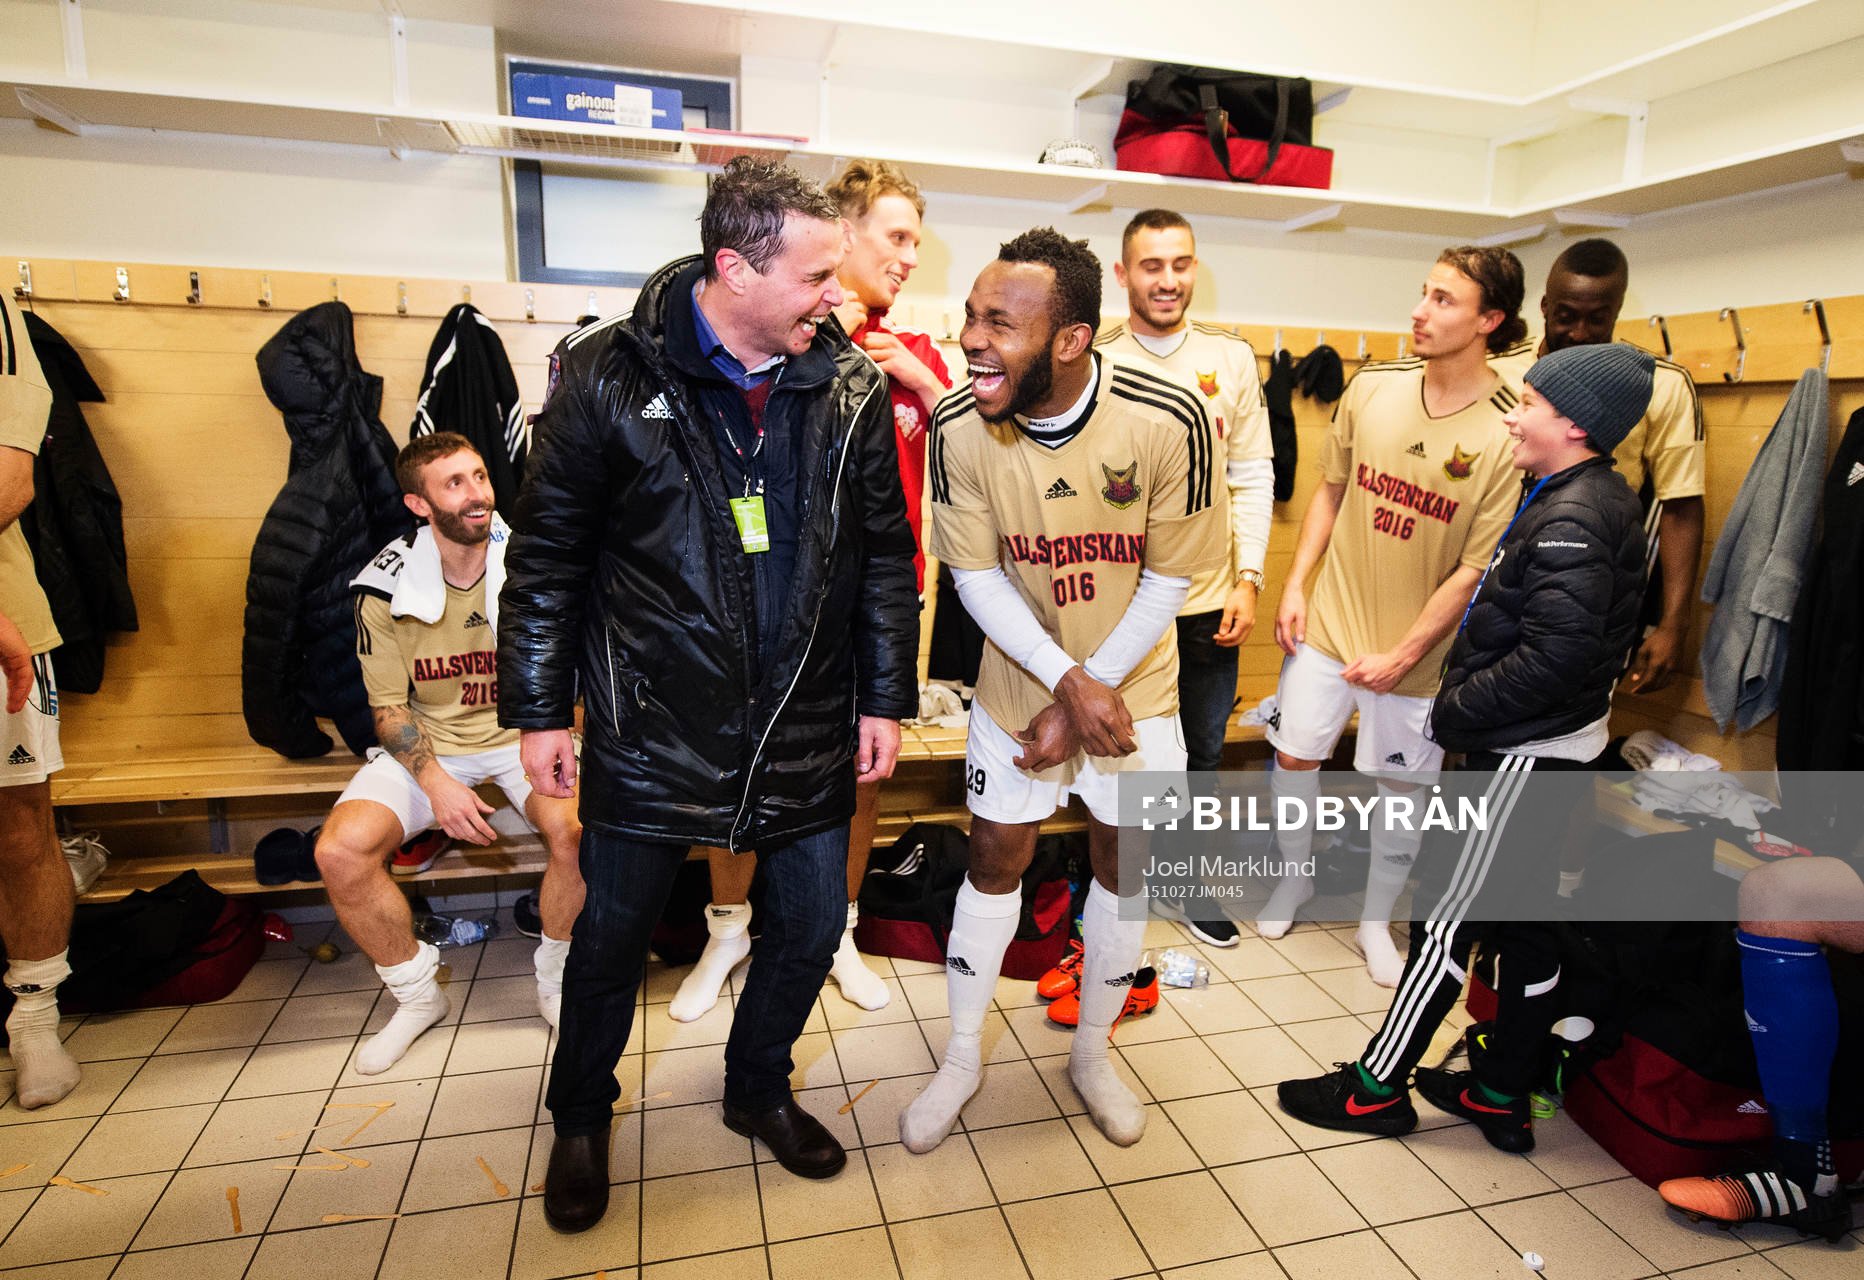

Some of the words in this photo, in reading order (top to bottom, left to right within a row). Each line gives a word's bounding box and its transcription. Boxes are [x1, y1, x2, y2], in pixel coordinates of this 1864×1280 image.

[566, 91, 616, 112] gainom
[641, 408, 675, 420] adida
[1044, 489, 1078, 500] adidas
[1373, 506, 1416, 541] 2016
[1050, 571, 1097, 608] 016
[414, 650, 497, 682] ALLSVEN
[967, 763, 986, 796] 29
